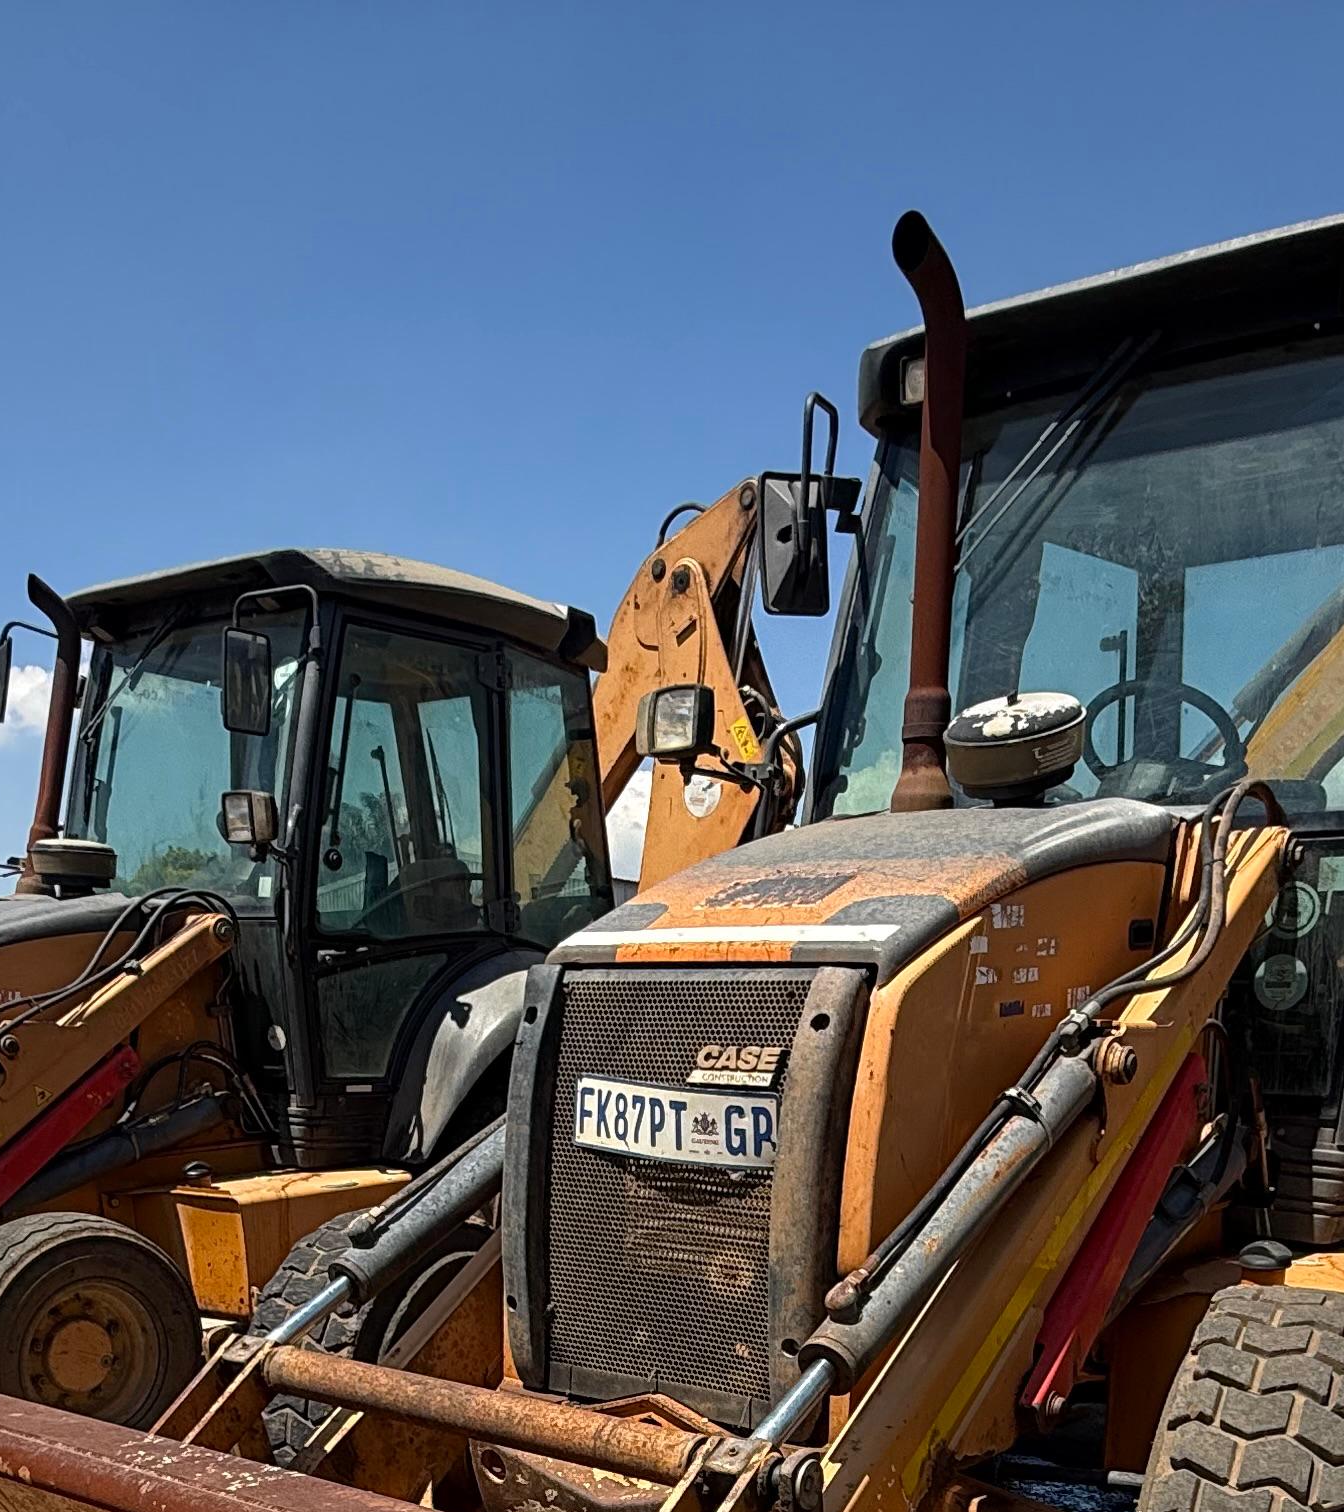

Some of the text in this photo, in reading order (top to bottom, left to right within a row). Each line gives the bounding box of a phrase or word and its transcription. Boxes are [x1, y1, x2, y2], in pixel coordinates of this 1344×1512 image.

[696, 1045, 782, 1071] CASE
[578, 1087, 773, 1158] FK87PT GP
